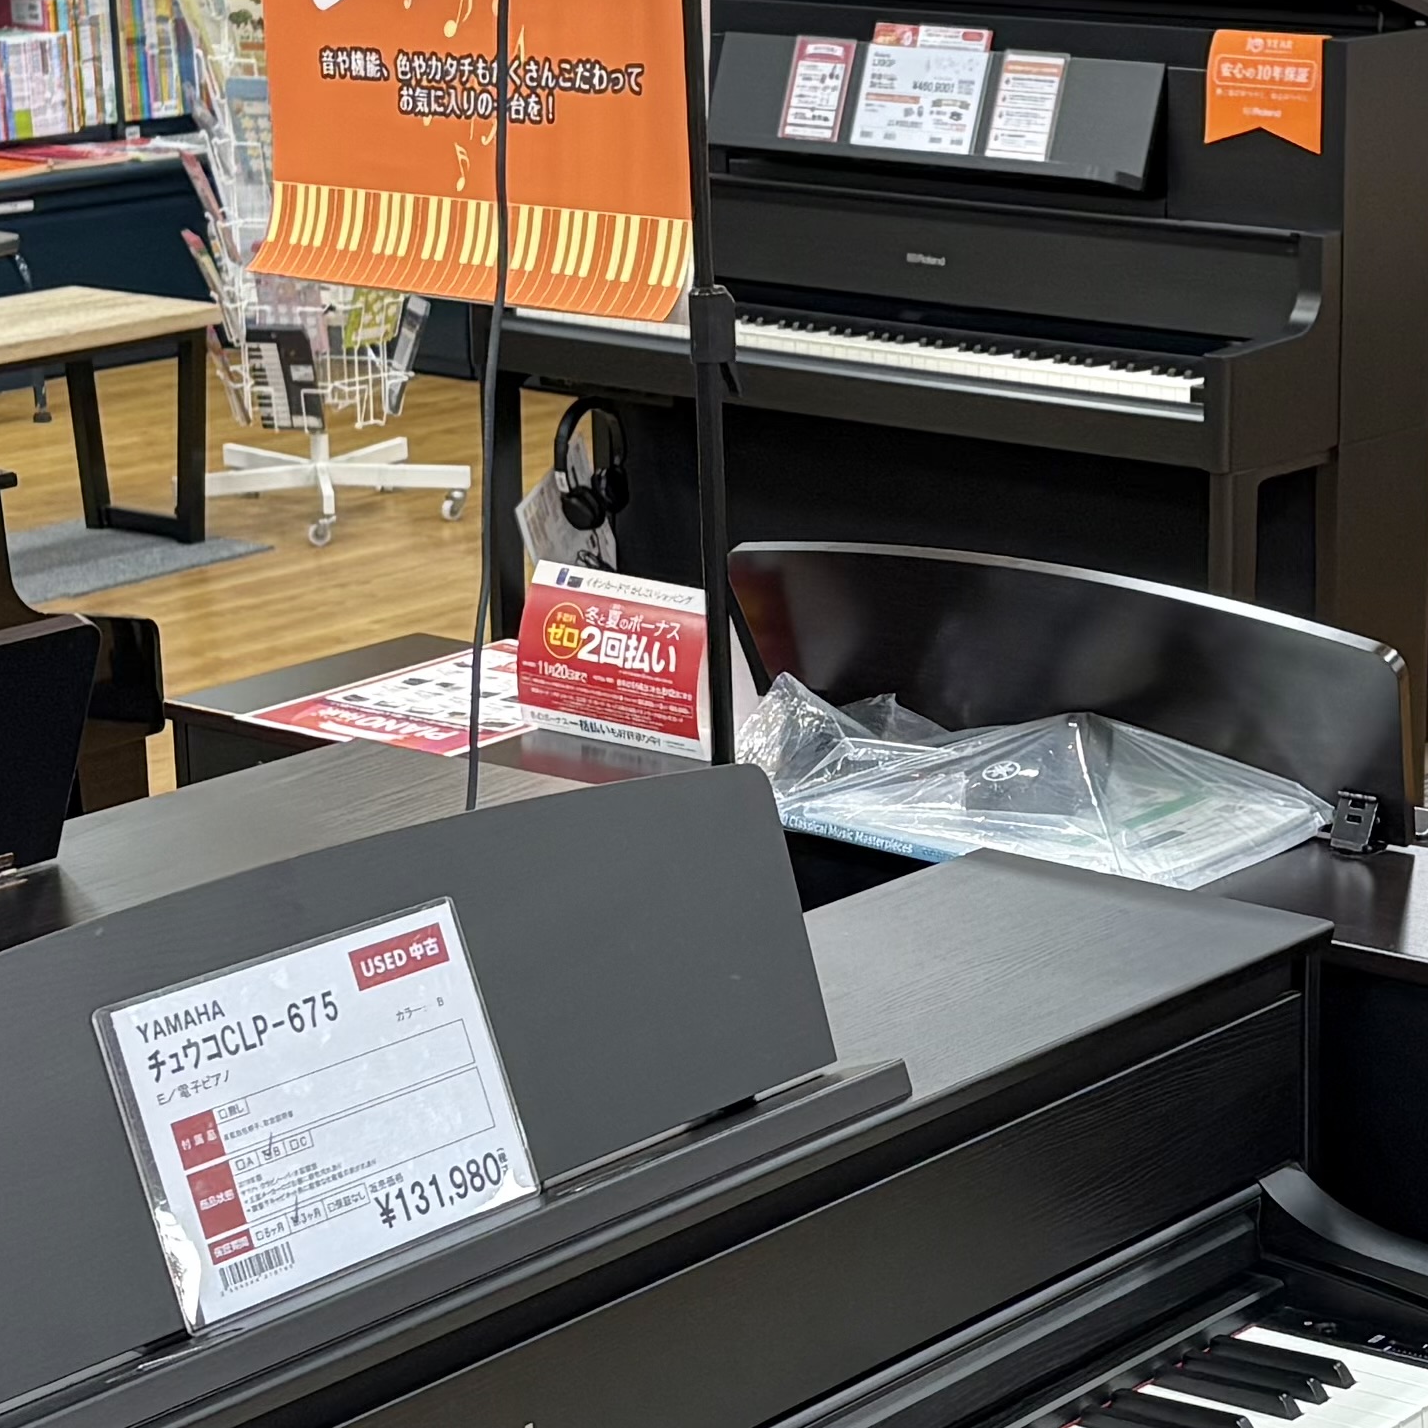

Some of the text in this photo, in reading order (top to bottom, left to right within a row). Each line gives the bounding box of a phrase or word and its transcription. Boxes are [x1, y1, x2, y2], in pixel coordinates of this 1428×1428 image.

[547, 623, 582, 649] ゼロ
[584, 605, 682, 641] 冬と夏のボーナス
[577, 626, 678, 673] 2回払い
[789, 815, 828, 835] Classical
[828, 824, 854, 841] Music
[855, 830, 914, 854] Masterpieces
[360, 935, 441, 979] USED 中古
[136, 999, 225, 1045] YAMAHA
[147, 990, 340, 1084] チュウコCLP-675
[272, 1146, 281, 1158] B
[299, 1135, 309, 1148] C
[245, 1156, 255, 1168] A
[333, 1191, 367, 1213] 保証なし
[374, 1151, 501, 1229] ¥131,980
